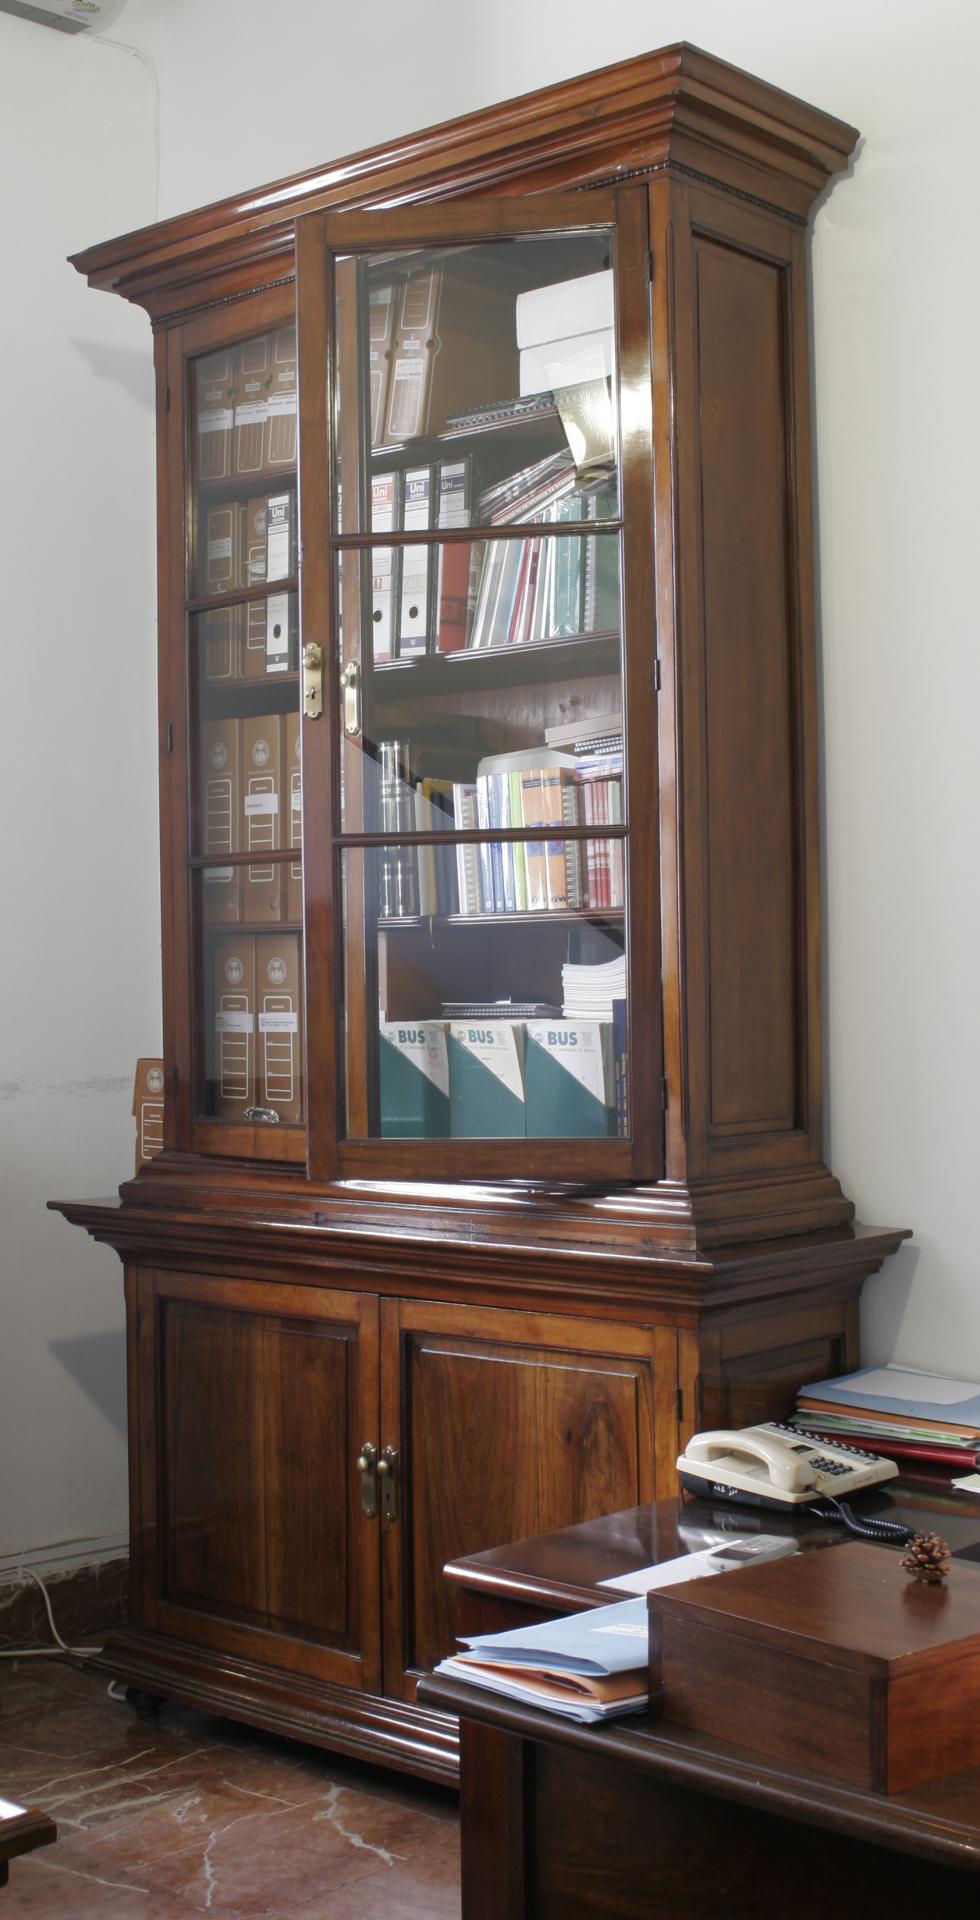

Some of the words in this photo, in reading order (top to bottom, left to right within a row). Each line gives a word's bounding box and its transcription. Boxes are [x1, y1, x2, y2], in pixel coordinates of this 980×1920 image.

[372, 485, 388, 498] Uni
[410, 482, 425, 493] Uni
[441, 480, 453, 490] Uni
[272, 506, 285, 518] Uni
[398, 1029, 426, 1044] BUS
[468, 1029, 494, 1044] BUS
[547, 1031, 578, 1046] BUS
